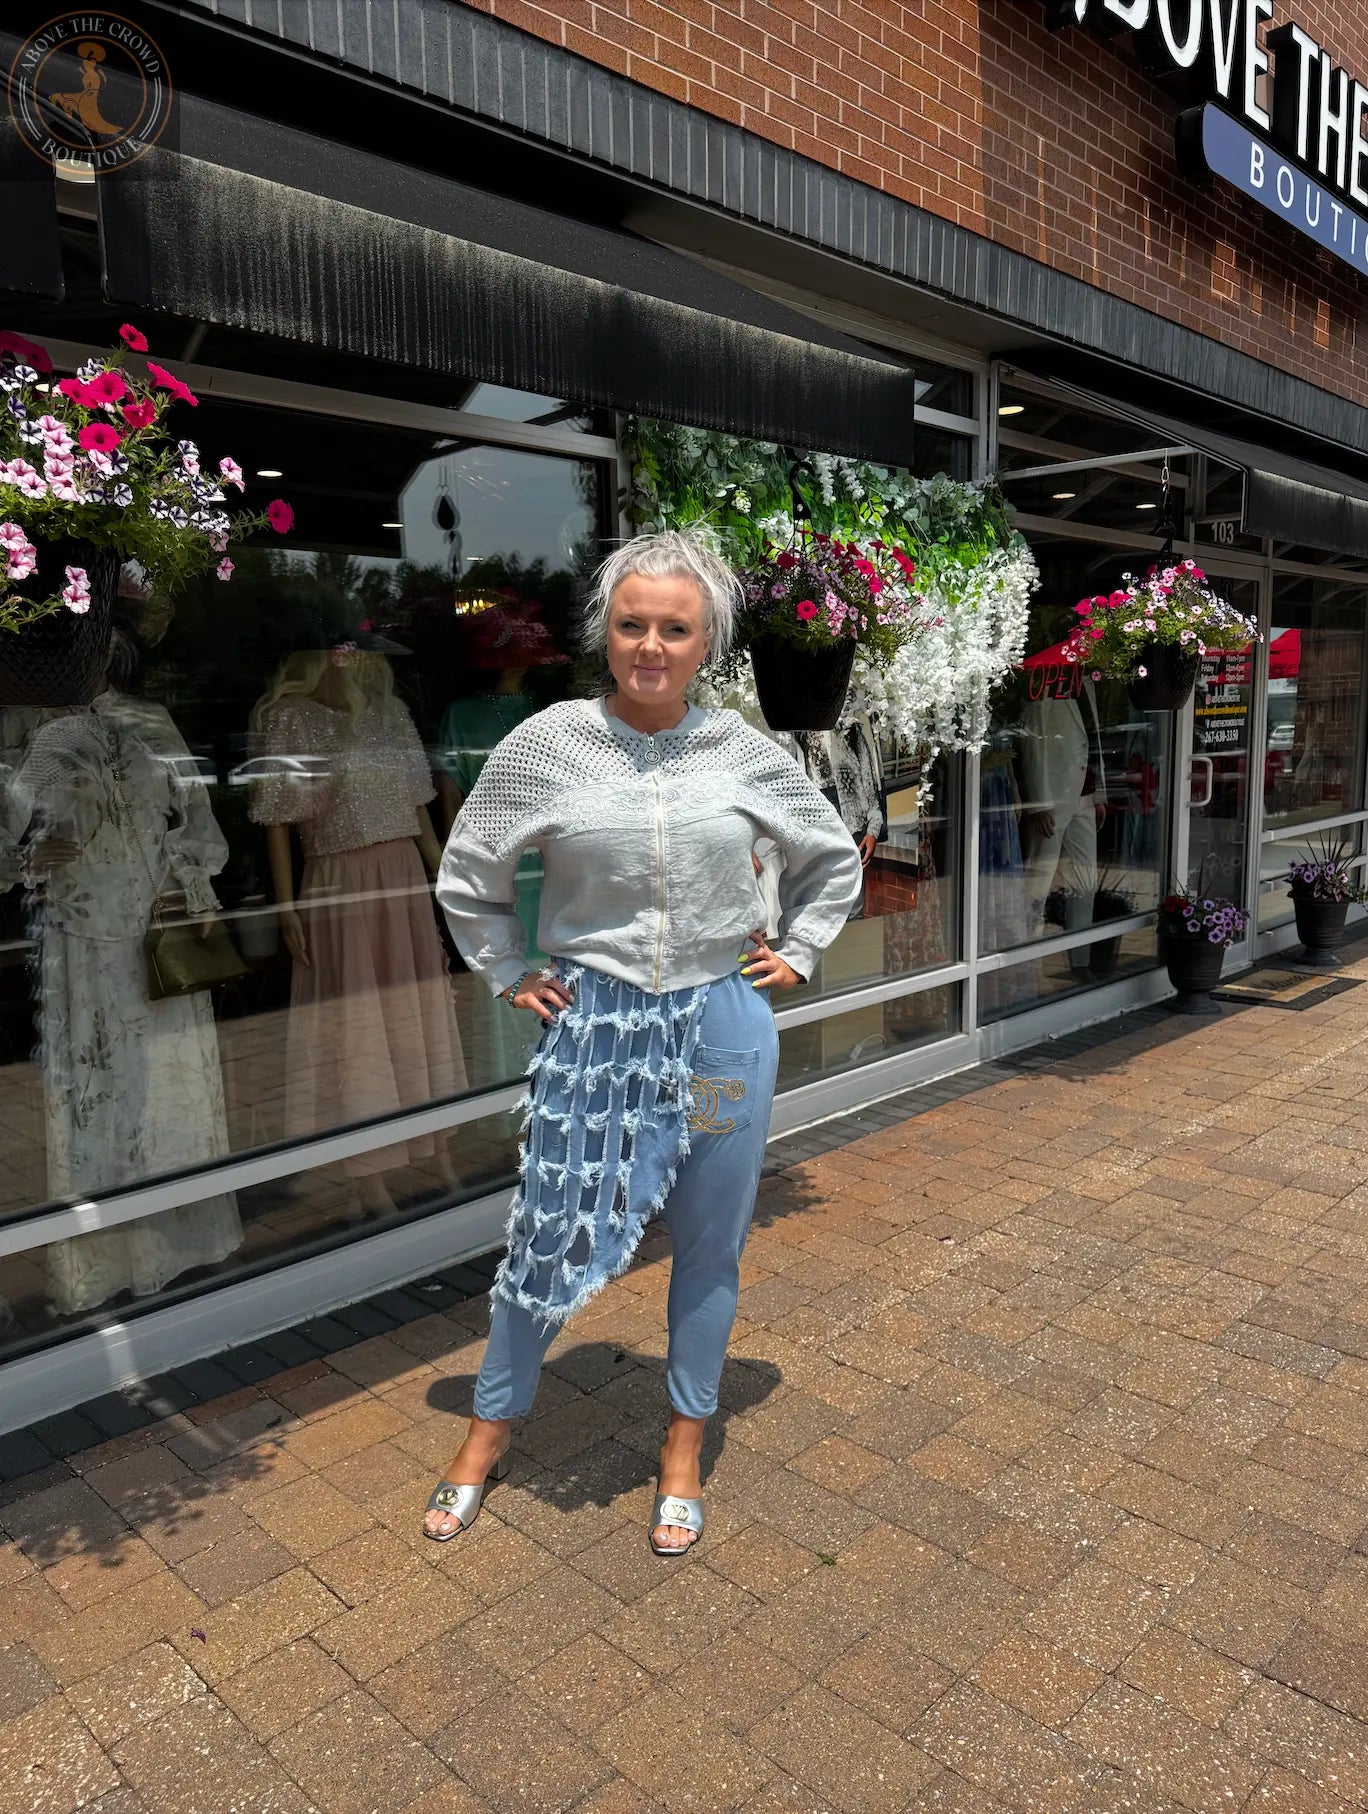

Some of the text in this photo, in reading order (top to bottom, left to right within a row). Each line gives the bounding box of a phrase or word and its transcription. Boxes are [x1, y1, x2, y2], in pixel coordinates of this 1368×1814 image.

[1074, 0, 1273, 132] OVE
[1250, 141, 1368, 263] BOUTI
[1212, 522, 1234, 544] 103
[1029, 660, 1085, 702] OPEN
[1201, 664, 1214, 672] Friday
